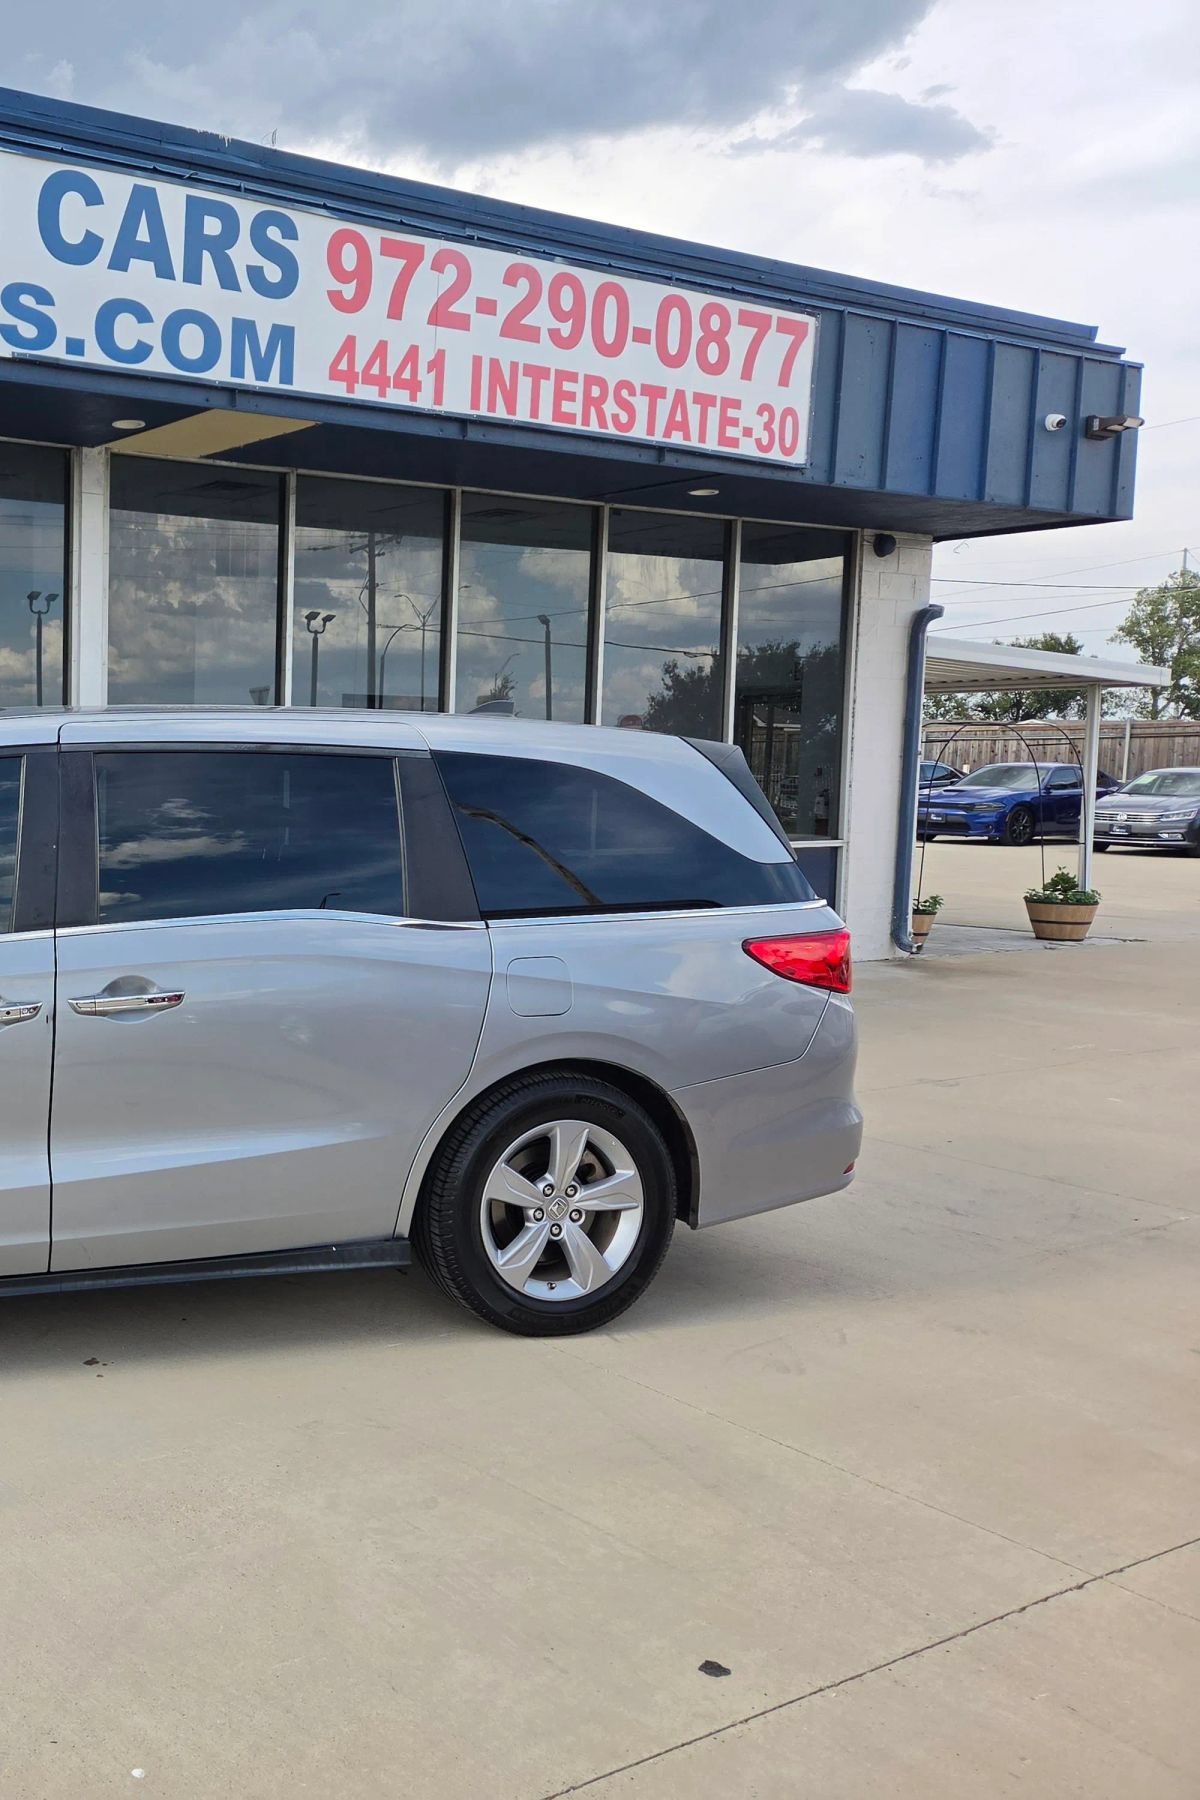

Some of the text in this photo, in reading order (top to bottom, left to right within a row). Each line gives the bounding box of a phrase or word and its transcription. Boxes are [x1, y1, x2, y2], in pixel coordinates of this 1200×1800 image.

[38, 169, 300, 300] CARS
[326, 228, 810, 388] 972-290-0877
[329, 334, 800, 458] 4441 INTERSTATE-30
